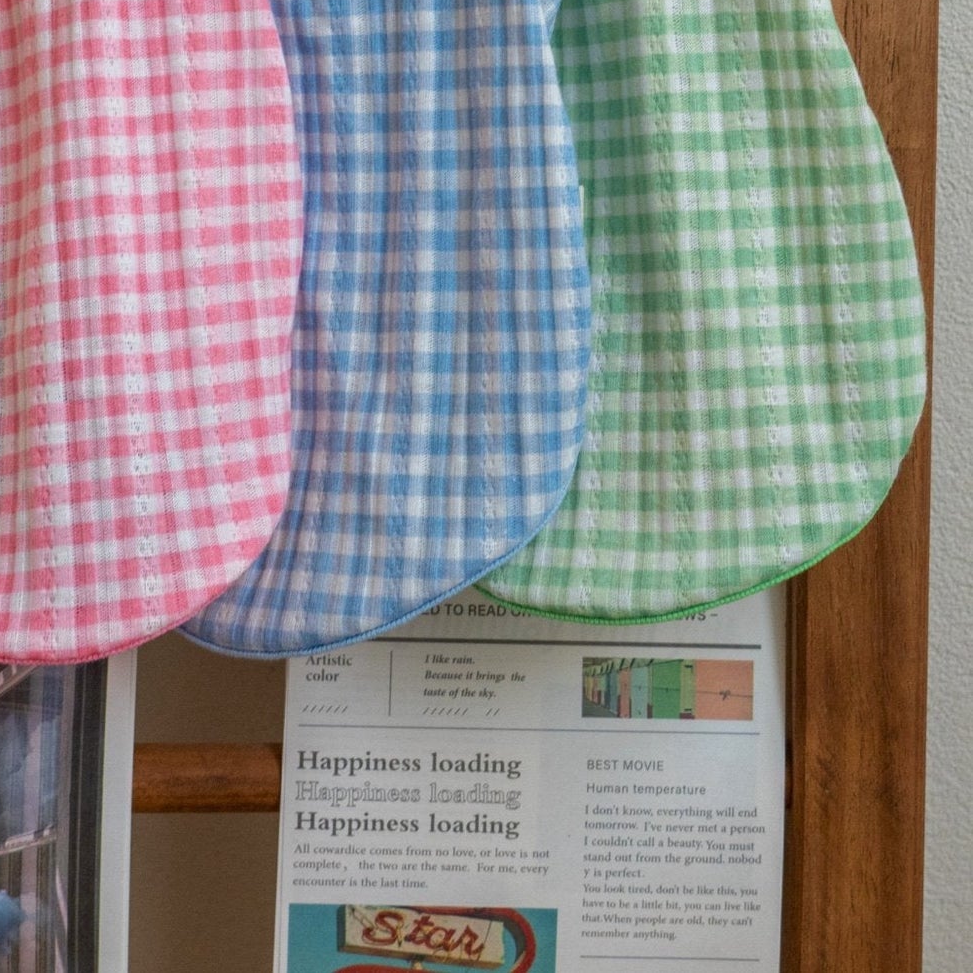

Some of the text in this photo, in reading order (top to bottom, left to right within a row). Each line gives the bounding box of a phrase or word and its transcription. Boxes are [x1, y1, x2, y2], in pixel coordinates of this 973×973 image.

[445, 603, 463, 616] TO
[468, 604, 506, 617] READ
[305, 654, 352, 666] Artistic
[431, 653, 450, 664] like
[452, 655, 475, 664] rain.
[305, 668, 339, 681] color
[424, 669, 526, 683] Because it brings the
[423, 686, 496, 700] taste of the sky.
[297, 750, 521, 779] Happiness loading
[587, 759, 663, 771] BEST MOVIE
[295, 781, 521, 810] Happiness loading
[586, 782, 706, 796] Human temperature
[622, 805, 653, 816] know,
[656, 806, 712, 820] everything
[715, 806, 735, 817] will
[737, 807, 757, 818] end
[294, 811, 520, 839] Happiness loading
[584, 820, 638, 830] tomorrow.
[665, 824, 694, 832] never
[697, 823, 717, 833] met
[729, 825, 765, 836] person
[293, 843, 549, 859] All cowardice comes from no love, or love is not
[636, 838, 654, 848] call
[667, 839, 703, 851] beauty.
[705, 840, 725, 851] You
[728, 841, 754, 851] must
[583, 852, 762, 866] stand out from the ground. nobod
[358, 859, 375, 870] the
[378, 861, 398, 870] two
[401, 863, 417, 871] are
[420, 860, 437, 871] the
[440, 864, 469, 872] same.
[477, 862, 495, 873] For
[498, 865, 517, 874] me,
[520, 865, 549, 876] every
[593, 867, 602, 877] is
[605, 867, 645, 880] perfect.
[292, 876, 427, 888] encounter is the last time.
[361, 910, 485, 961] Star
[581, 928, 677, 941] remember anything.
